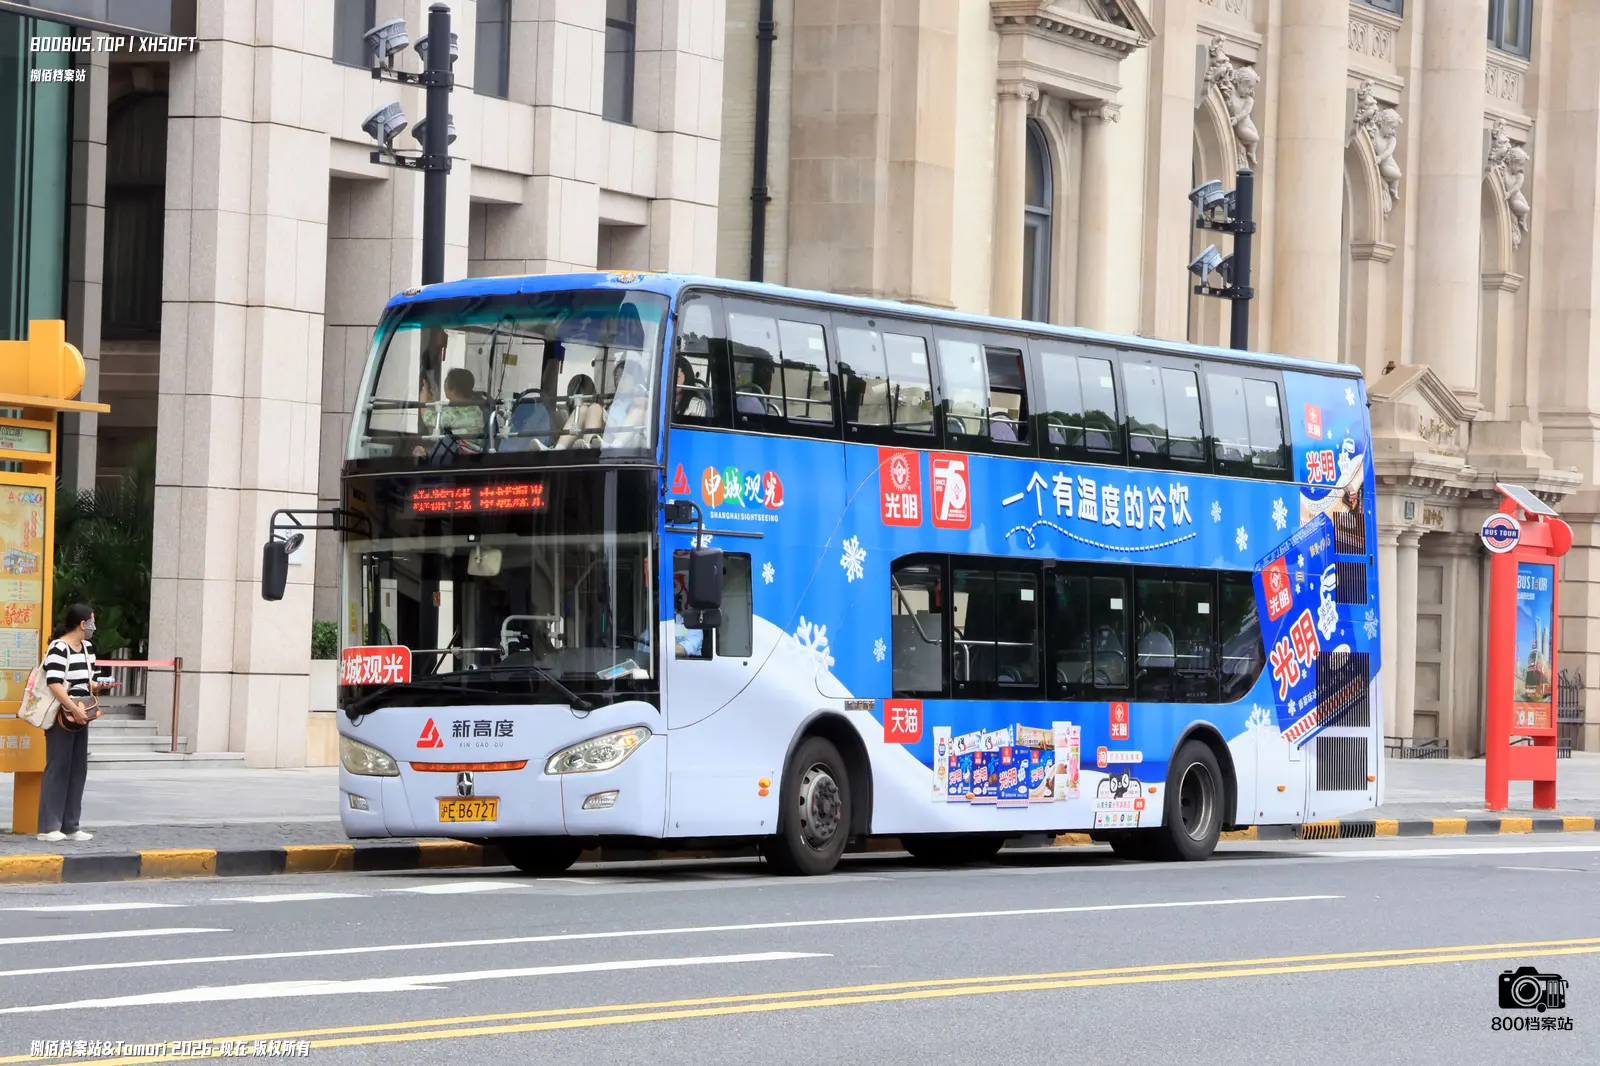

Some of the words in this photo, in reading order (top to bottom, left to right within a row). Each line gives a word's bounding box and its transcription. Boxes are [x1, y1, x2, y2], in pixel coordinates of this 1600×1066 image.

[1306, 450, 1336, 483] 光明
[705, 466, 784, 509] 申城观光
[885, 493, 919, 519] 光明
[1002, 471, 1192, 530] 一个有温度的冷饮
[710, 511, 740, 520] SHANGHAI
[741, 513, 779, 522] SIGHTSEEING
[1517, 575, 1530, 590] BUS
[1269, 588, 1290, 616] 光明
[1270, 608, 1320, 701] 光明
[452, 719, 514, 738] 新高度
[891, 708, 918, 733] 天猫
[1112, 723, 1128, 736] 光明
[999, 767, 1018, 790] 光明
